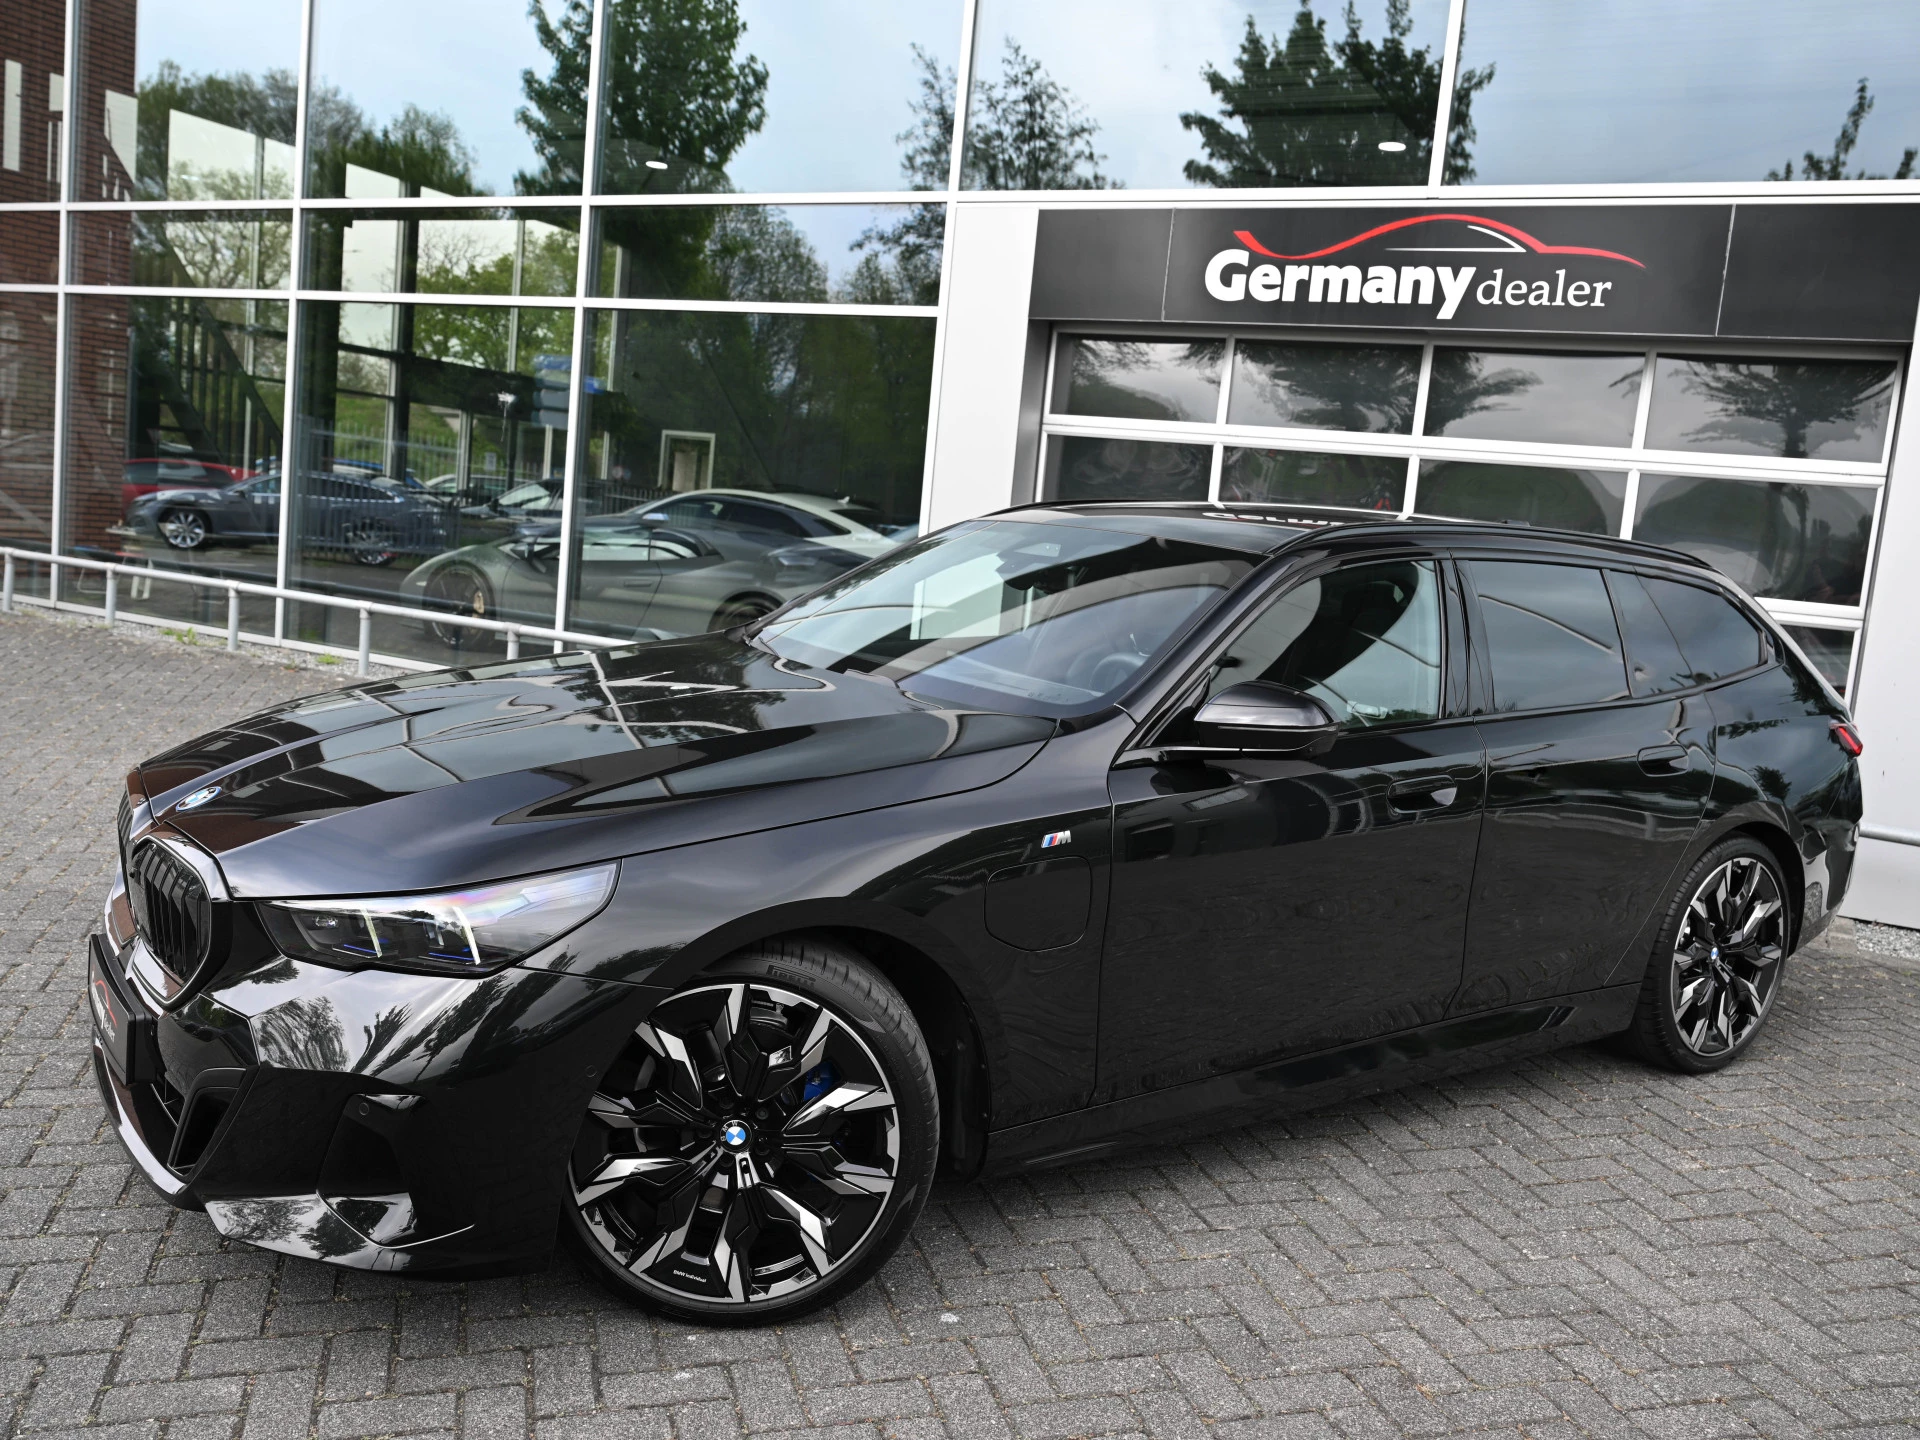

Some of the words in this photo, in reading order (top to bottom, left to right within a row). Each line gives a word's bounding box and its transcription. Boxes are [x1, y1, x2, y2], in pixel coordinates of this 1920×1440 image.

[1204, 248, 1477, 320] Germany
[1476, 268, 1613, 308] dealer
[673, 1269, 686, 1277] BMW
